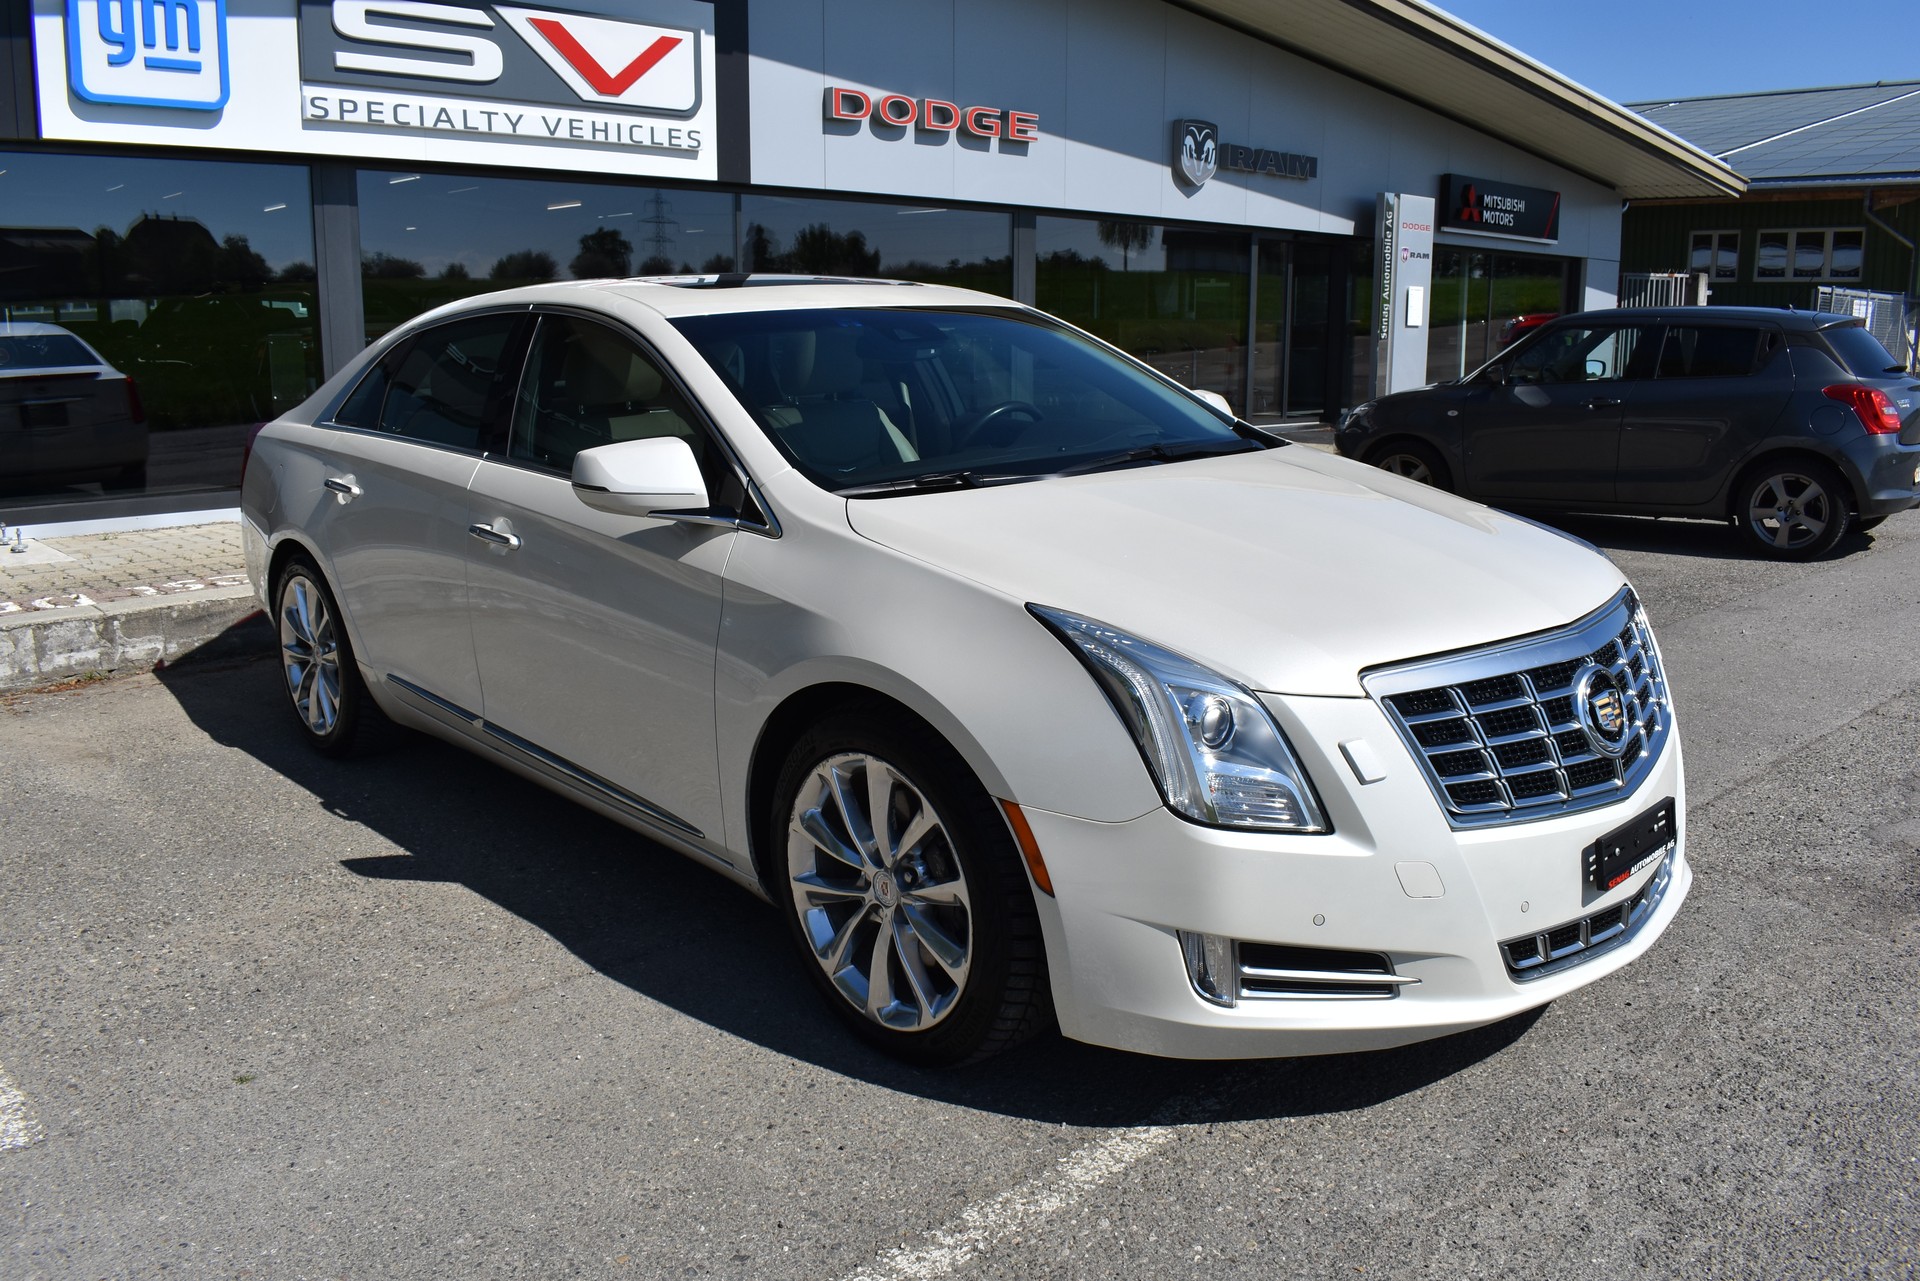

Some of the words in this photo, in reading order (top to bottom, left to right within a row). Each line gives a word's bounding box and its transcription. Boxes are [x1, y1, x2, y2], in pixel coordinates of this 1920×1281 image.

[97, 0, 203, 68] gm
[310, 96, 524, 134] SPECIALTY
[541, 116, 702, 149] VEHICLES
[830, 86, 1039, 142] DODGE
[1227, 143, 1318, 179] RAM
[1385, 211, 1393, 228] AG
[1482, 210, 1514, 227] MOTORS
[1483, 194, 1526, 213] MITSUBISHI
[1402, 222, 1431, 232] DODGE
[1383, 231, 1392, 300] Automobile
[1409, 251, 1430, 260] RAM
[1630, 845, 1667, 875] AUTOMOBILE
[1667, 839, 1675, 851] AG
